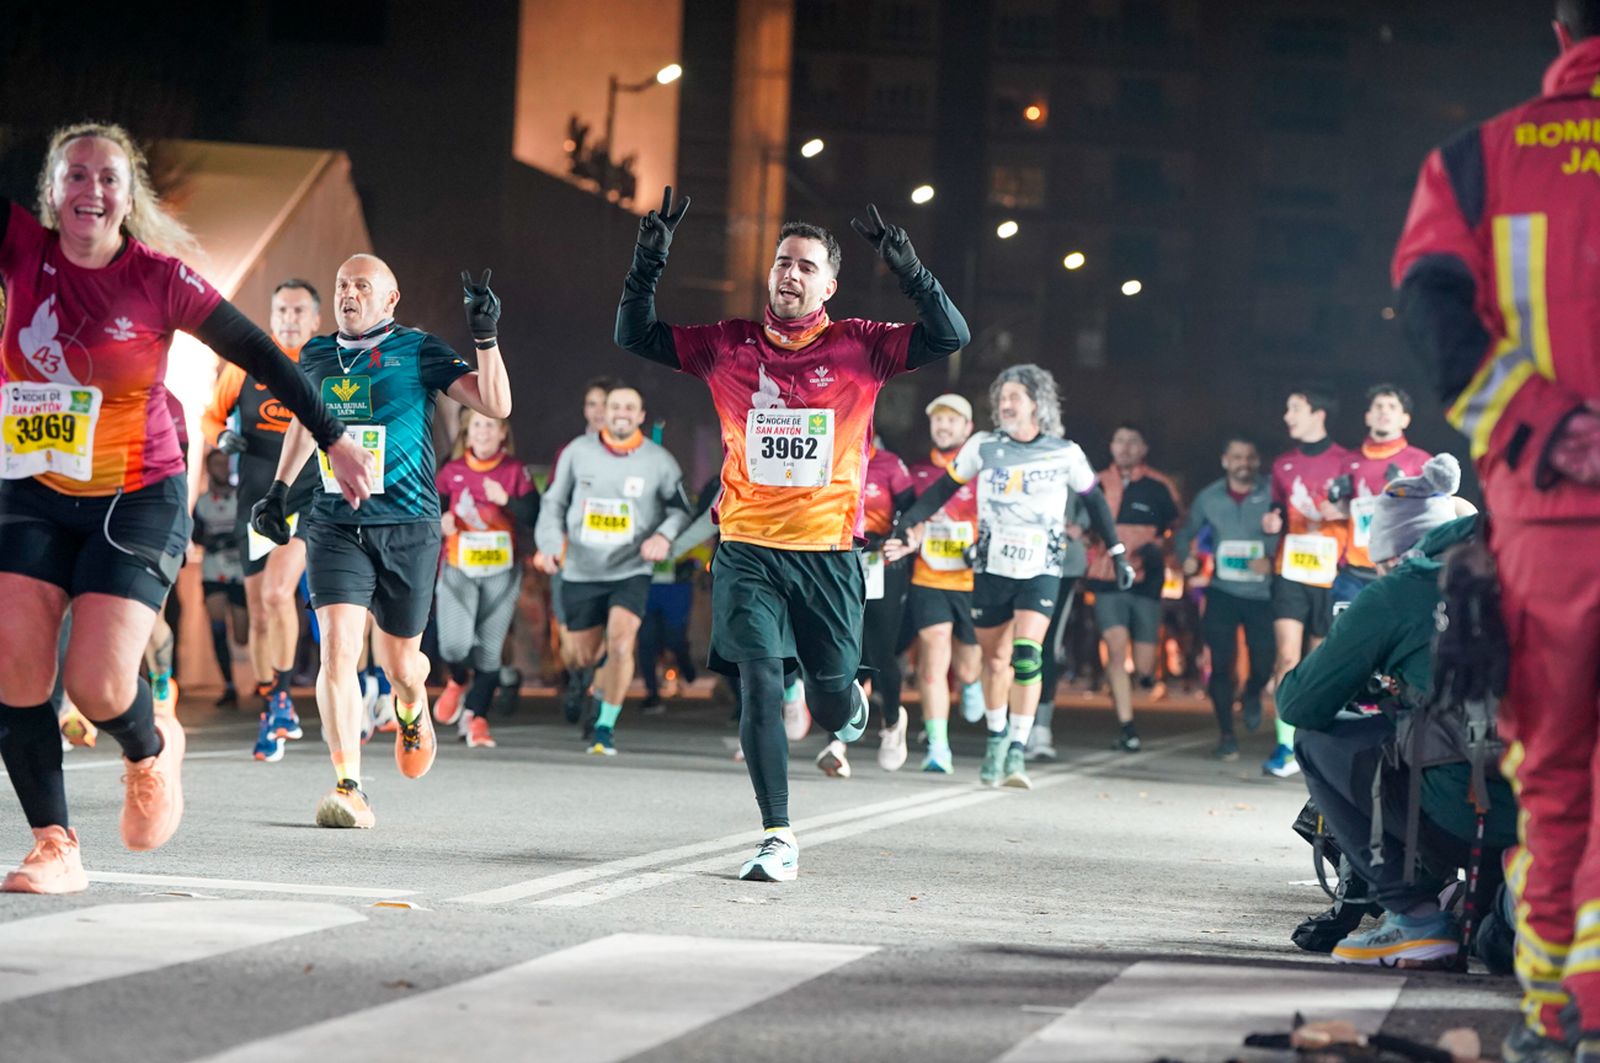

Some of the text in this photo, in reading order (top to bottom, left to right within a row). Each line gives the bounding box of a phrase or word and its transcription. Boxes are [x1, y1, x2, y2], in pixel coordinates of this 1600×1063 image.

[32, 346, 61, 374] 43
[22, 392, 61, 402] NOCHE DE
[11, 405, 28, 415] SAN
[766, 417, 802, 425] NOCHE DE
[16, 413, 76, 445] 3969
[756, 426, 772, 435] SAN
[761, 436, 818, 460] 3962
[1001, 544, 1034, 561] 4207
